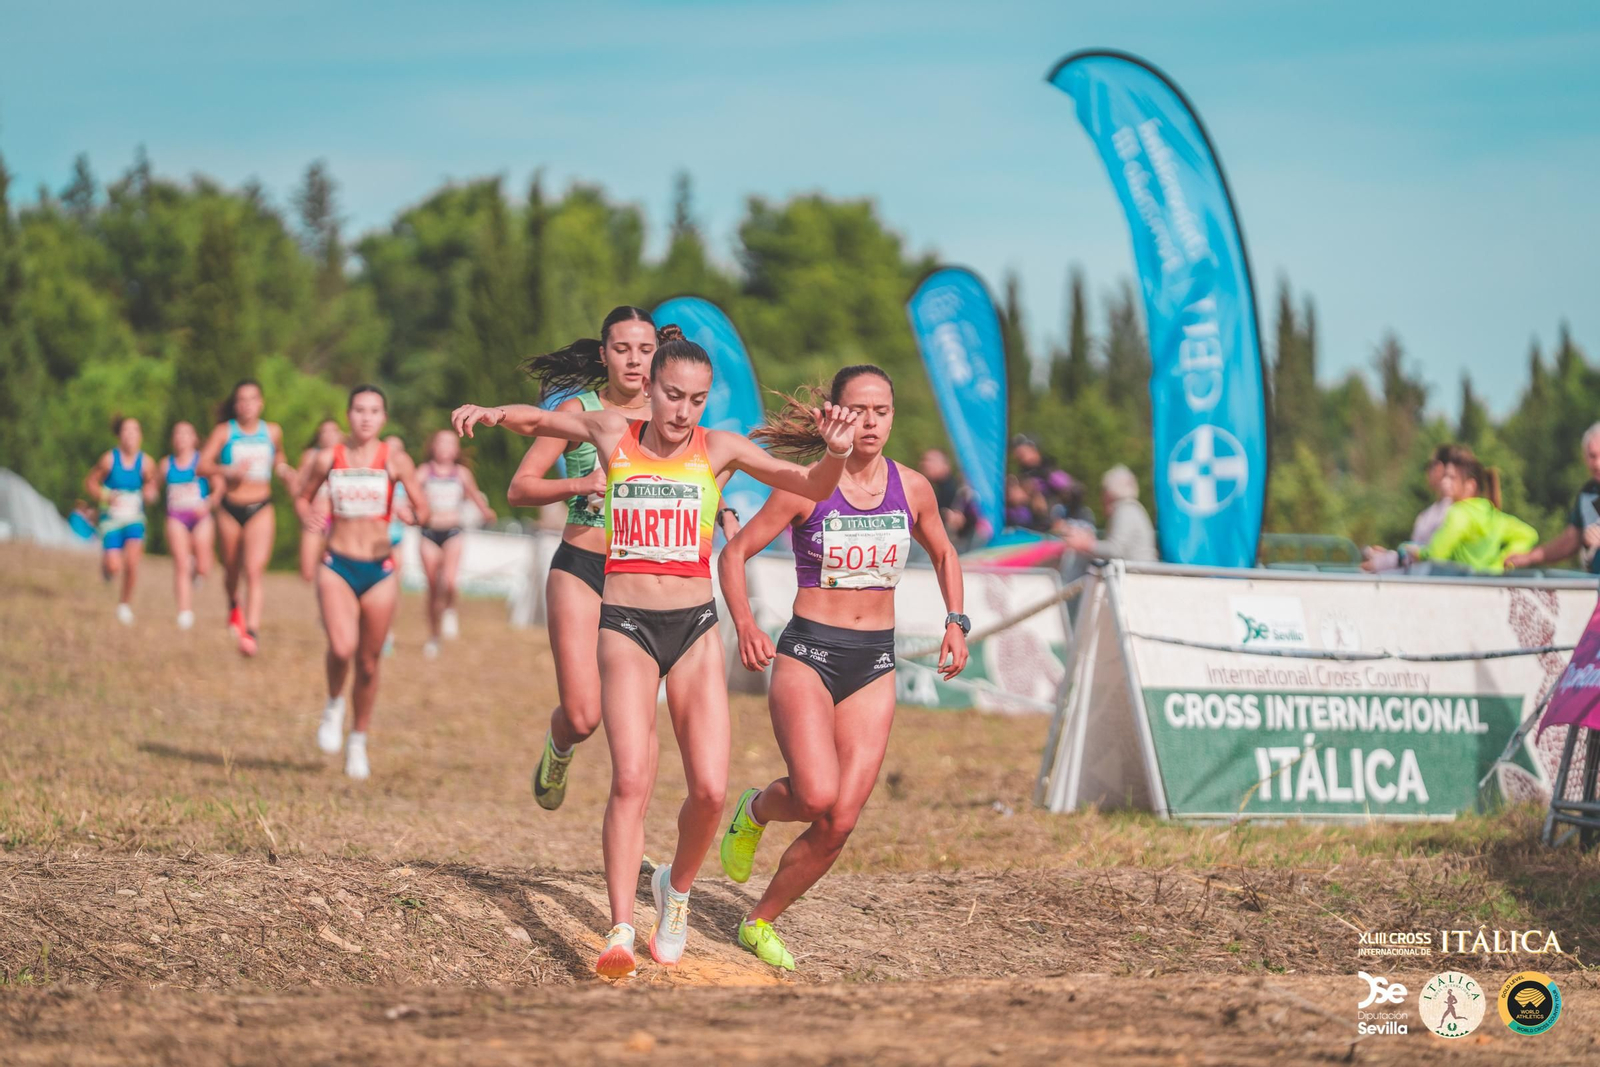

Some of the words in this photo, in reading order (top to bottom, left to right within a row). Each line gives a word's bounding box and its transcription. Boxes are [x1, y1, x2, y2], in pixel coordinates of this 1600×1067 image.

[634, 484, 677, 496] ITÁLICA
[613, 499, 697, 547] MARTÍN
[847, 517, 886, 529] ITÁLICA
[826, 544, 898, 571] 5014
[1206, 665, 1314, 686] International
[1314, 665, 1362, 688] Cross
[1364, 666, 1431, 696] Country
[1164, 693, 1262, 729] CROSS
[1265, 694, 1490, 733] INTERNACIONAL
[1255, 733, 1430, 804] ITÁLICA
